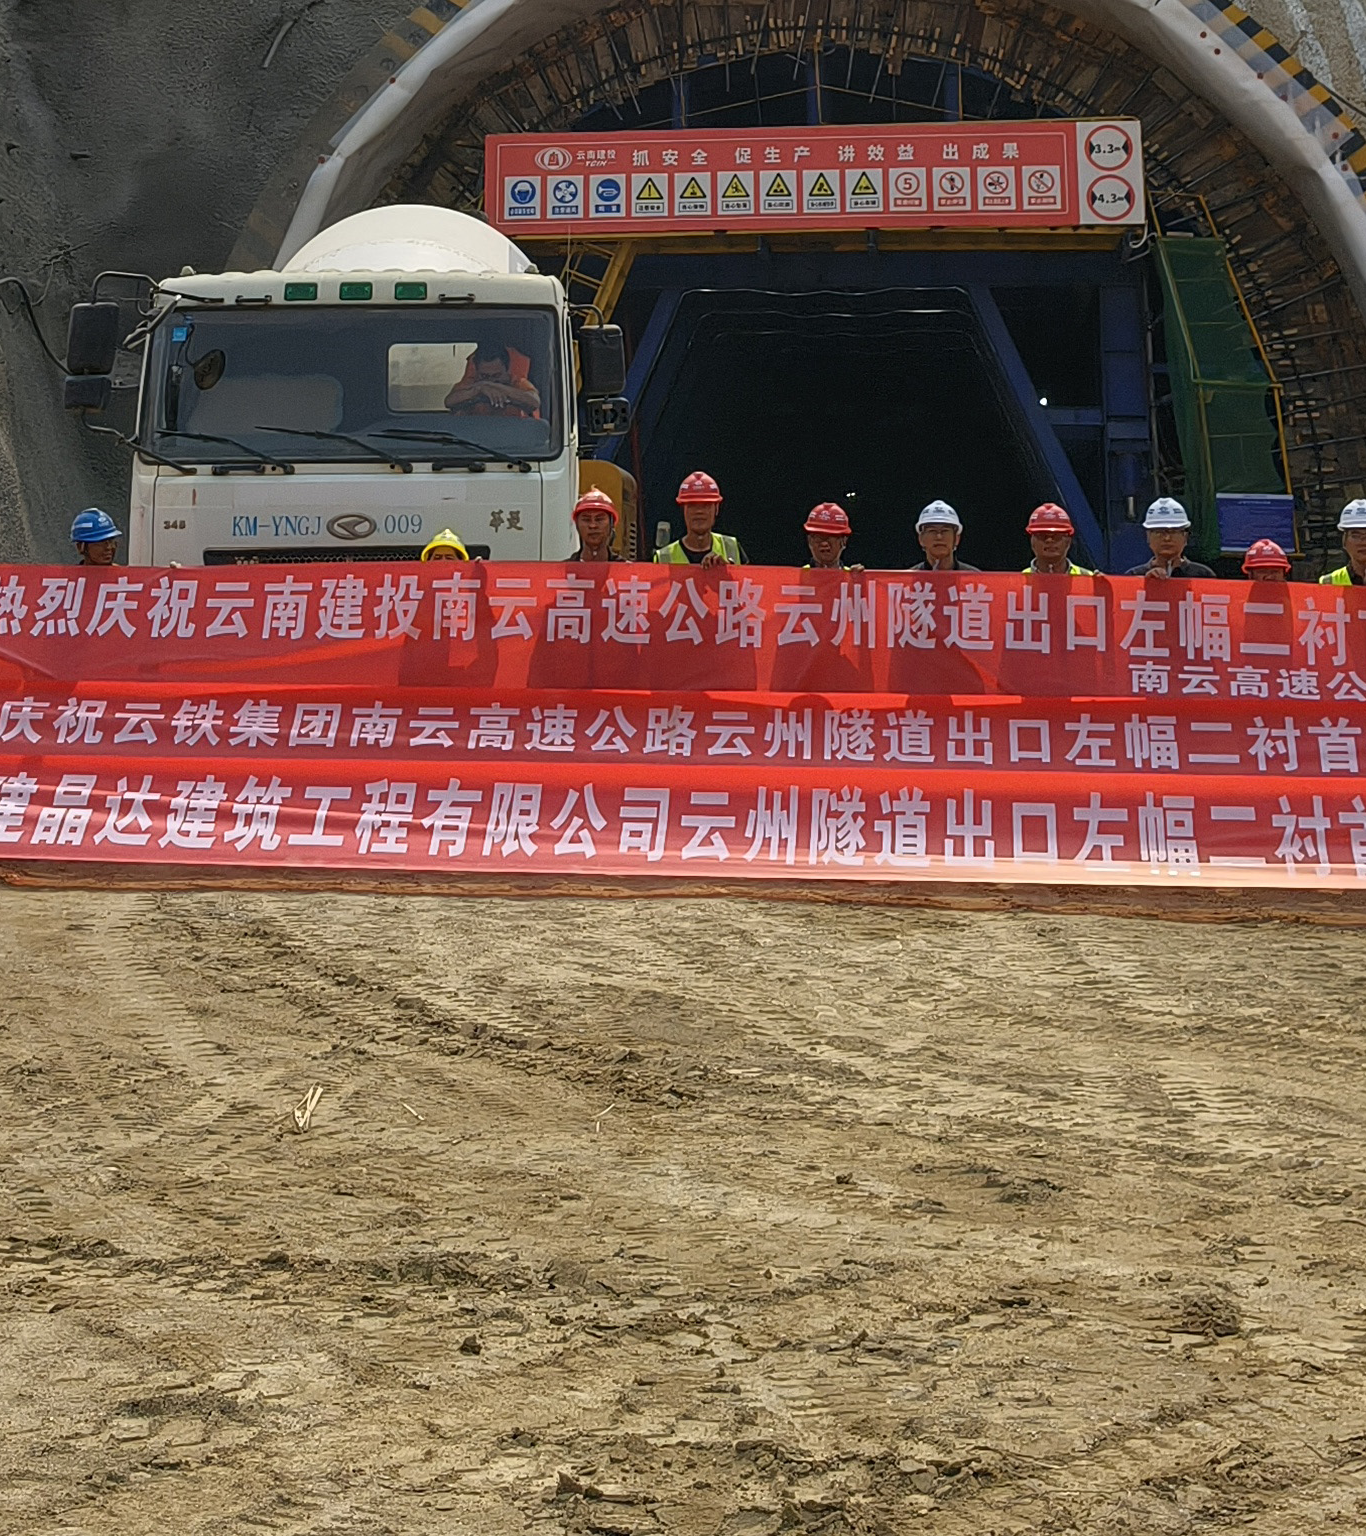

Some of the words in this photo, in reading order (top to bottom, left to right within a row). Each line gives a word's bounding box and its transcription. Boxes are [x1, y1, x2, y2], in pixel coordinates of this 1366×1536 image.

[632, 149, 708, 167] 抓安全
[735, 146, 811, 165] 促生产
[837, 144, 915, 163] 讲效益
[942, 142, 1020, 161] 出成果
[903, 178, 913, 190] 5
[232, 515, 322, 536] KM-YNGJ
